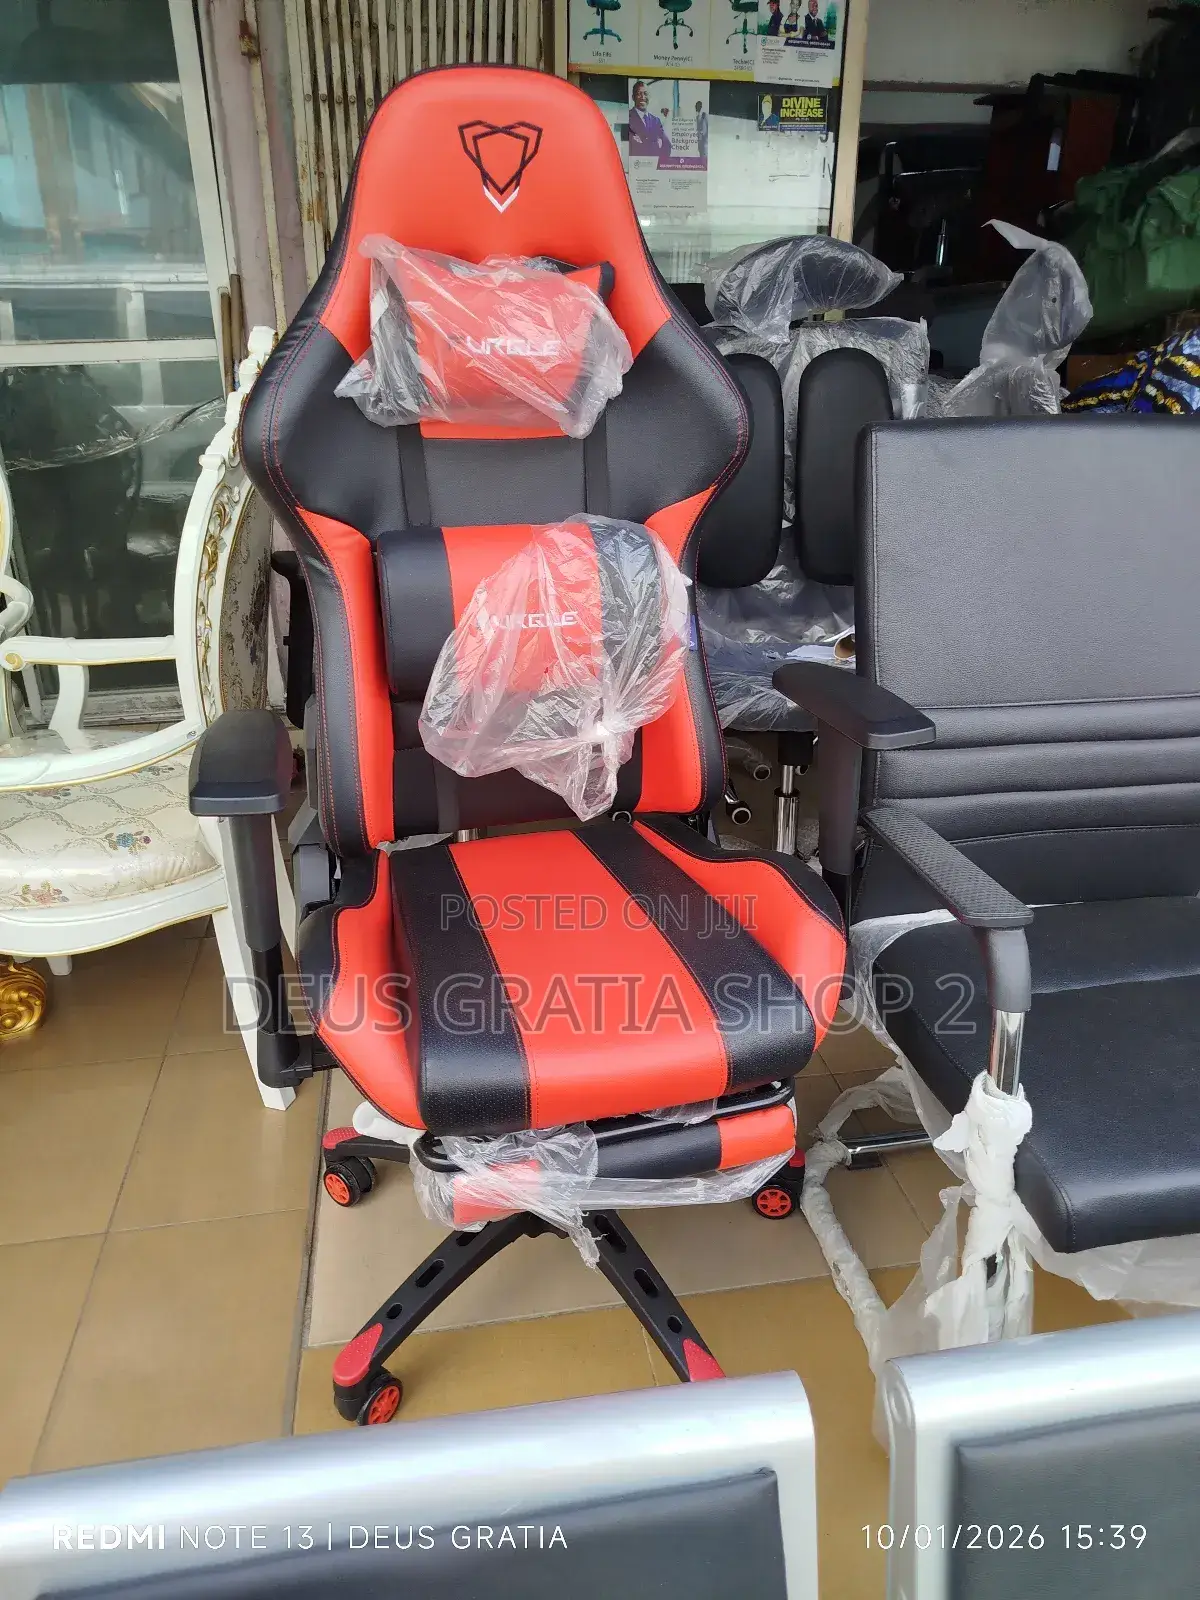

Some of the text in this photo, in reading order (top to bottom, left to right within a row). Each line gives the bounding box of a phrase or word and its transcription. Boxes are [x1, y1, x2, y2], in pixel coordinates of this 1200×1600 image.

[653, 54, 670, 62] Money
[782, 97, 821, 109] DIVINE
[780, 108, 824, 118] INCREASE
